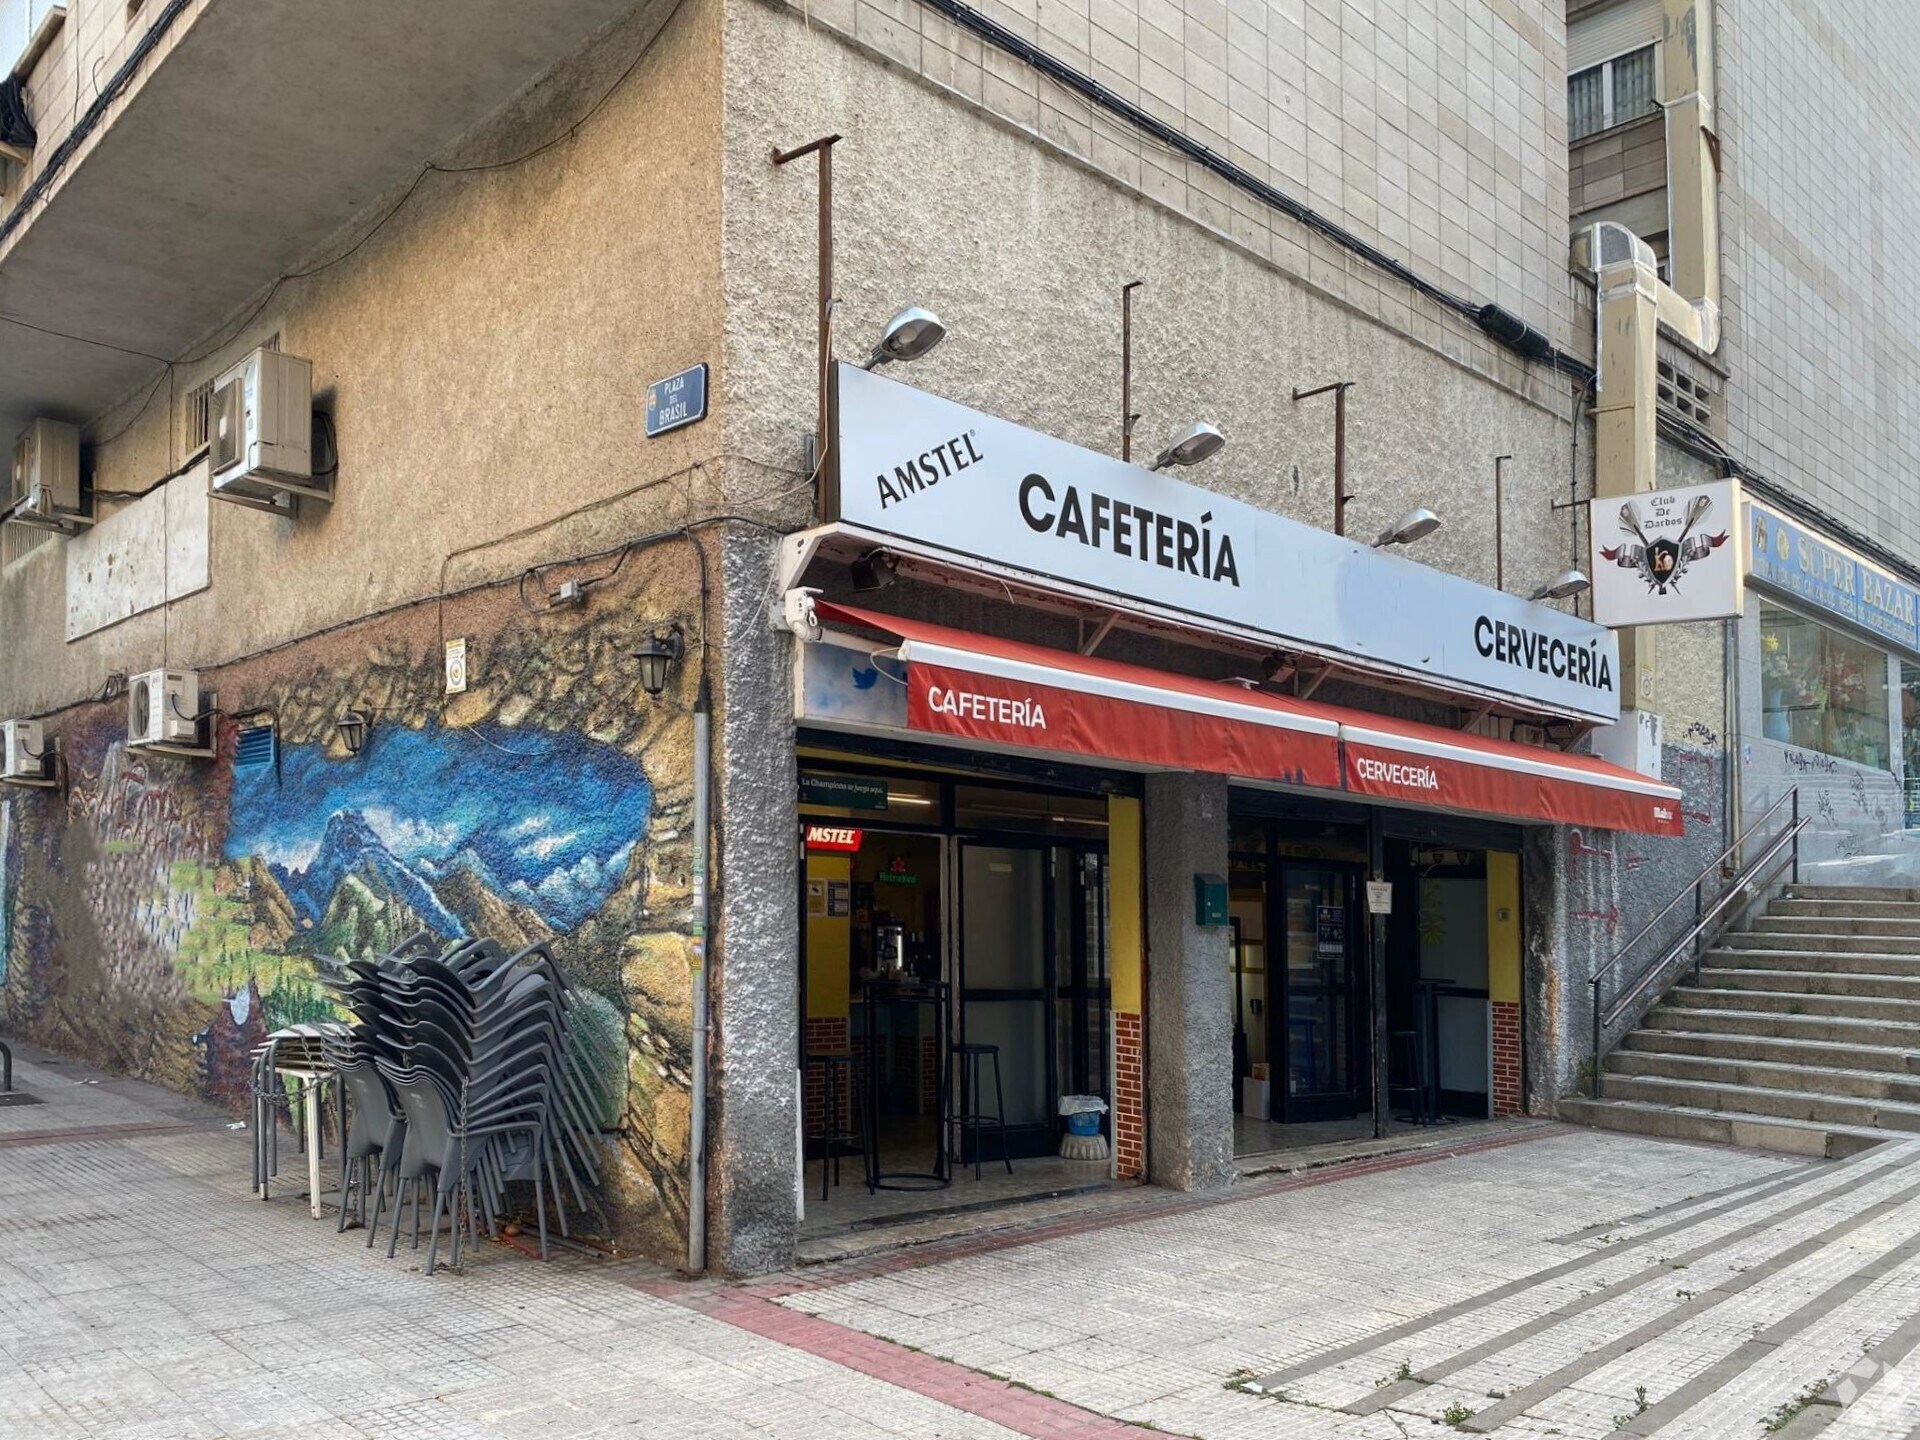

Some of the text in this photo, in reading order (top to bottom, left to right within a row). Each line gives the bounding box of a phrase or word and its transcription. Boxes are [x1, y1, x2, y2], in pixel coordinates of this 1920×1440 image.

[665, 376, 685, 395] PLAZA
[659, 401, 688, 426] BRASIL
[1650, 496, 1676, 507] Club
[1655, 508, 1671, 517] De
[1018, 472, 1241, 588] CAFETERÍA
[1643, 518, 1683, 530] Dardos
[1798, 536, 1856, 597] SUPER
[1862, 567, 1915, 627] BAZAR
[1473, 615, 1613, 692] CERVECERÍA
[927, 685, 1048, 730] CAFETERÍA
[1356, 757, 1440, 790] CERVECERÍA
[806, 826, 856, 844] MSTEL
